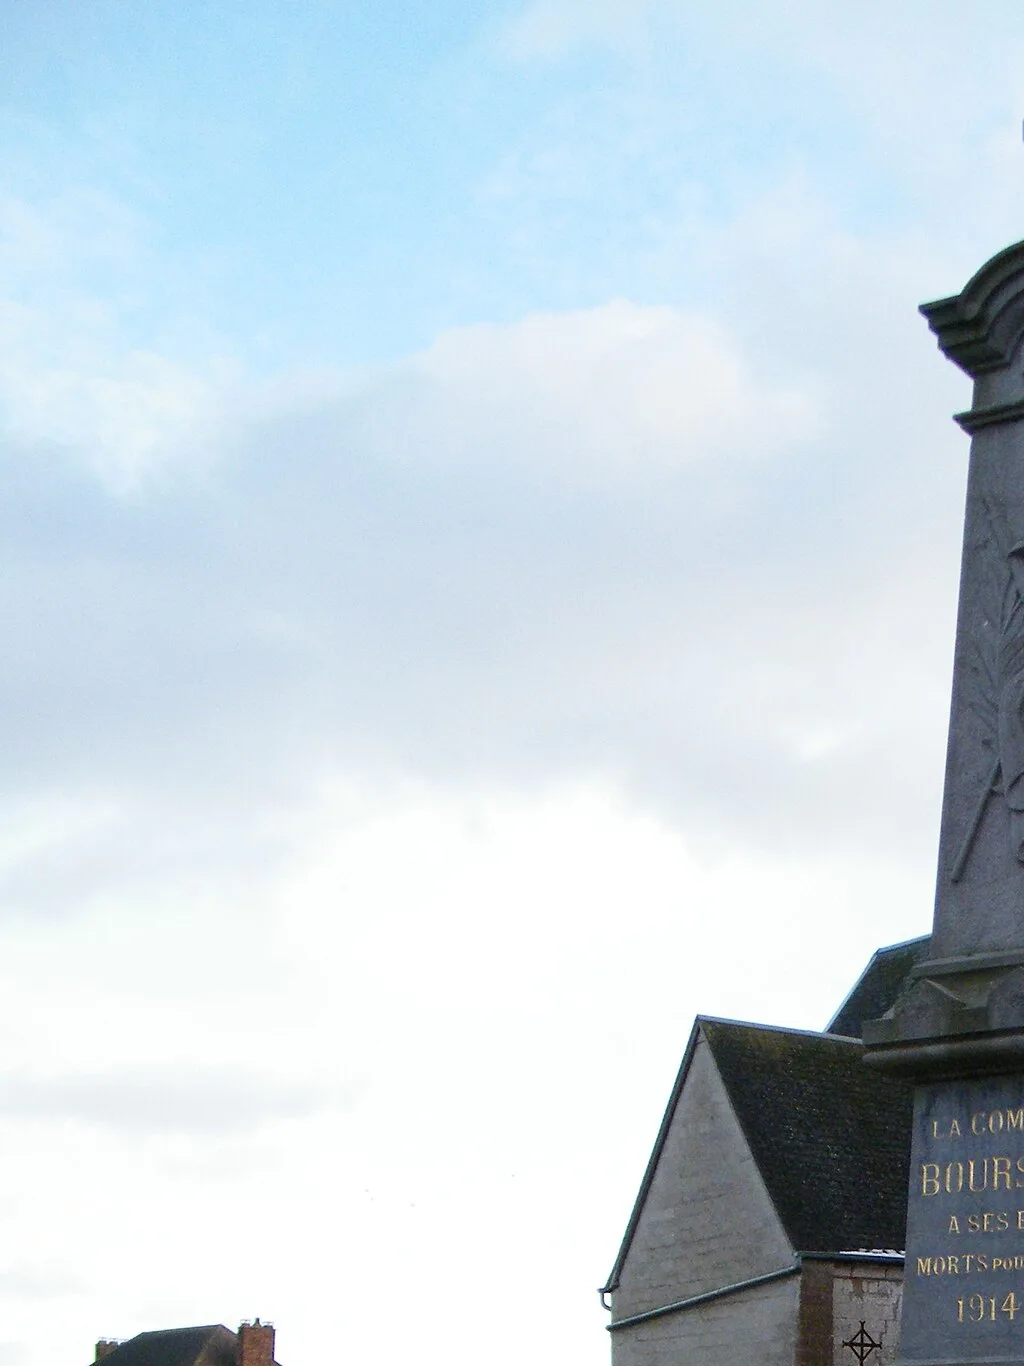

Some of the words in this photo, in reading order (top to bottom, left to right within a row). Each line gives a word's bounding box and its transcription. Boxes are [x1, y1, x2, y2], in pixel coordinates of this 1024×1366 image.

[933, 1119, 961, 1139] LA
[948, 1214, 960, 1234] A
[967, 1211, 1009, 1233] SES
[916, 1253, 988, 1276] MORTS
